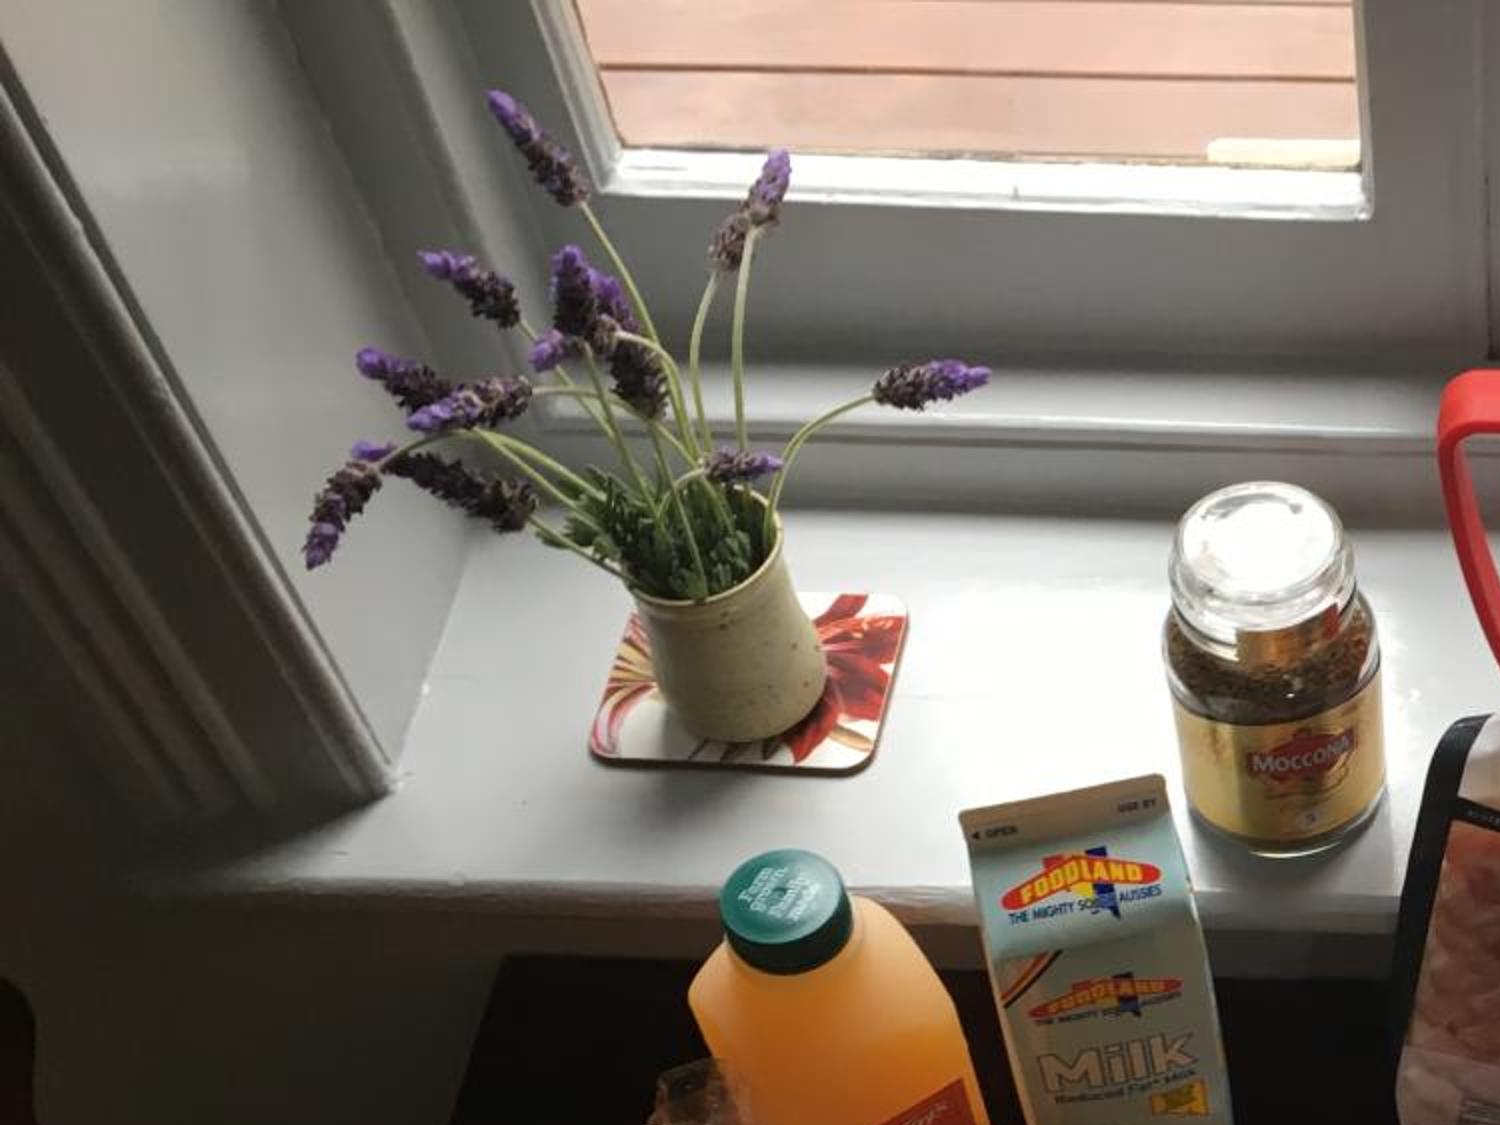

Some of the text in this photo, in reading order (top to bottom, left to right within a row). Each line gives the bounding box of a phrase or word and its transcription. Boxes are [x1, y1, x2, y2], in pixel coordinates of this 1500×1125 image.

[1019, 855, 1144, 904] FOODLAND
[1008, 909, 1029, 925] THE
[1032, 902, 1074, 922] MIGHTY
[1119, 884, 1163, 903] AUSSIES
[1036, 1031, 1200, 1095] Milk
